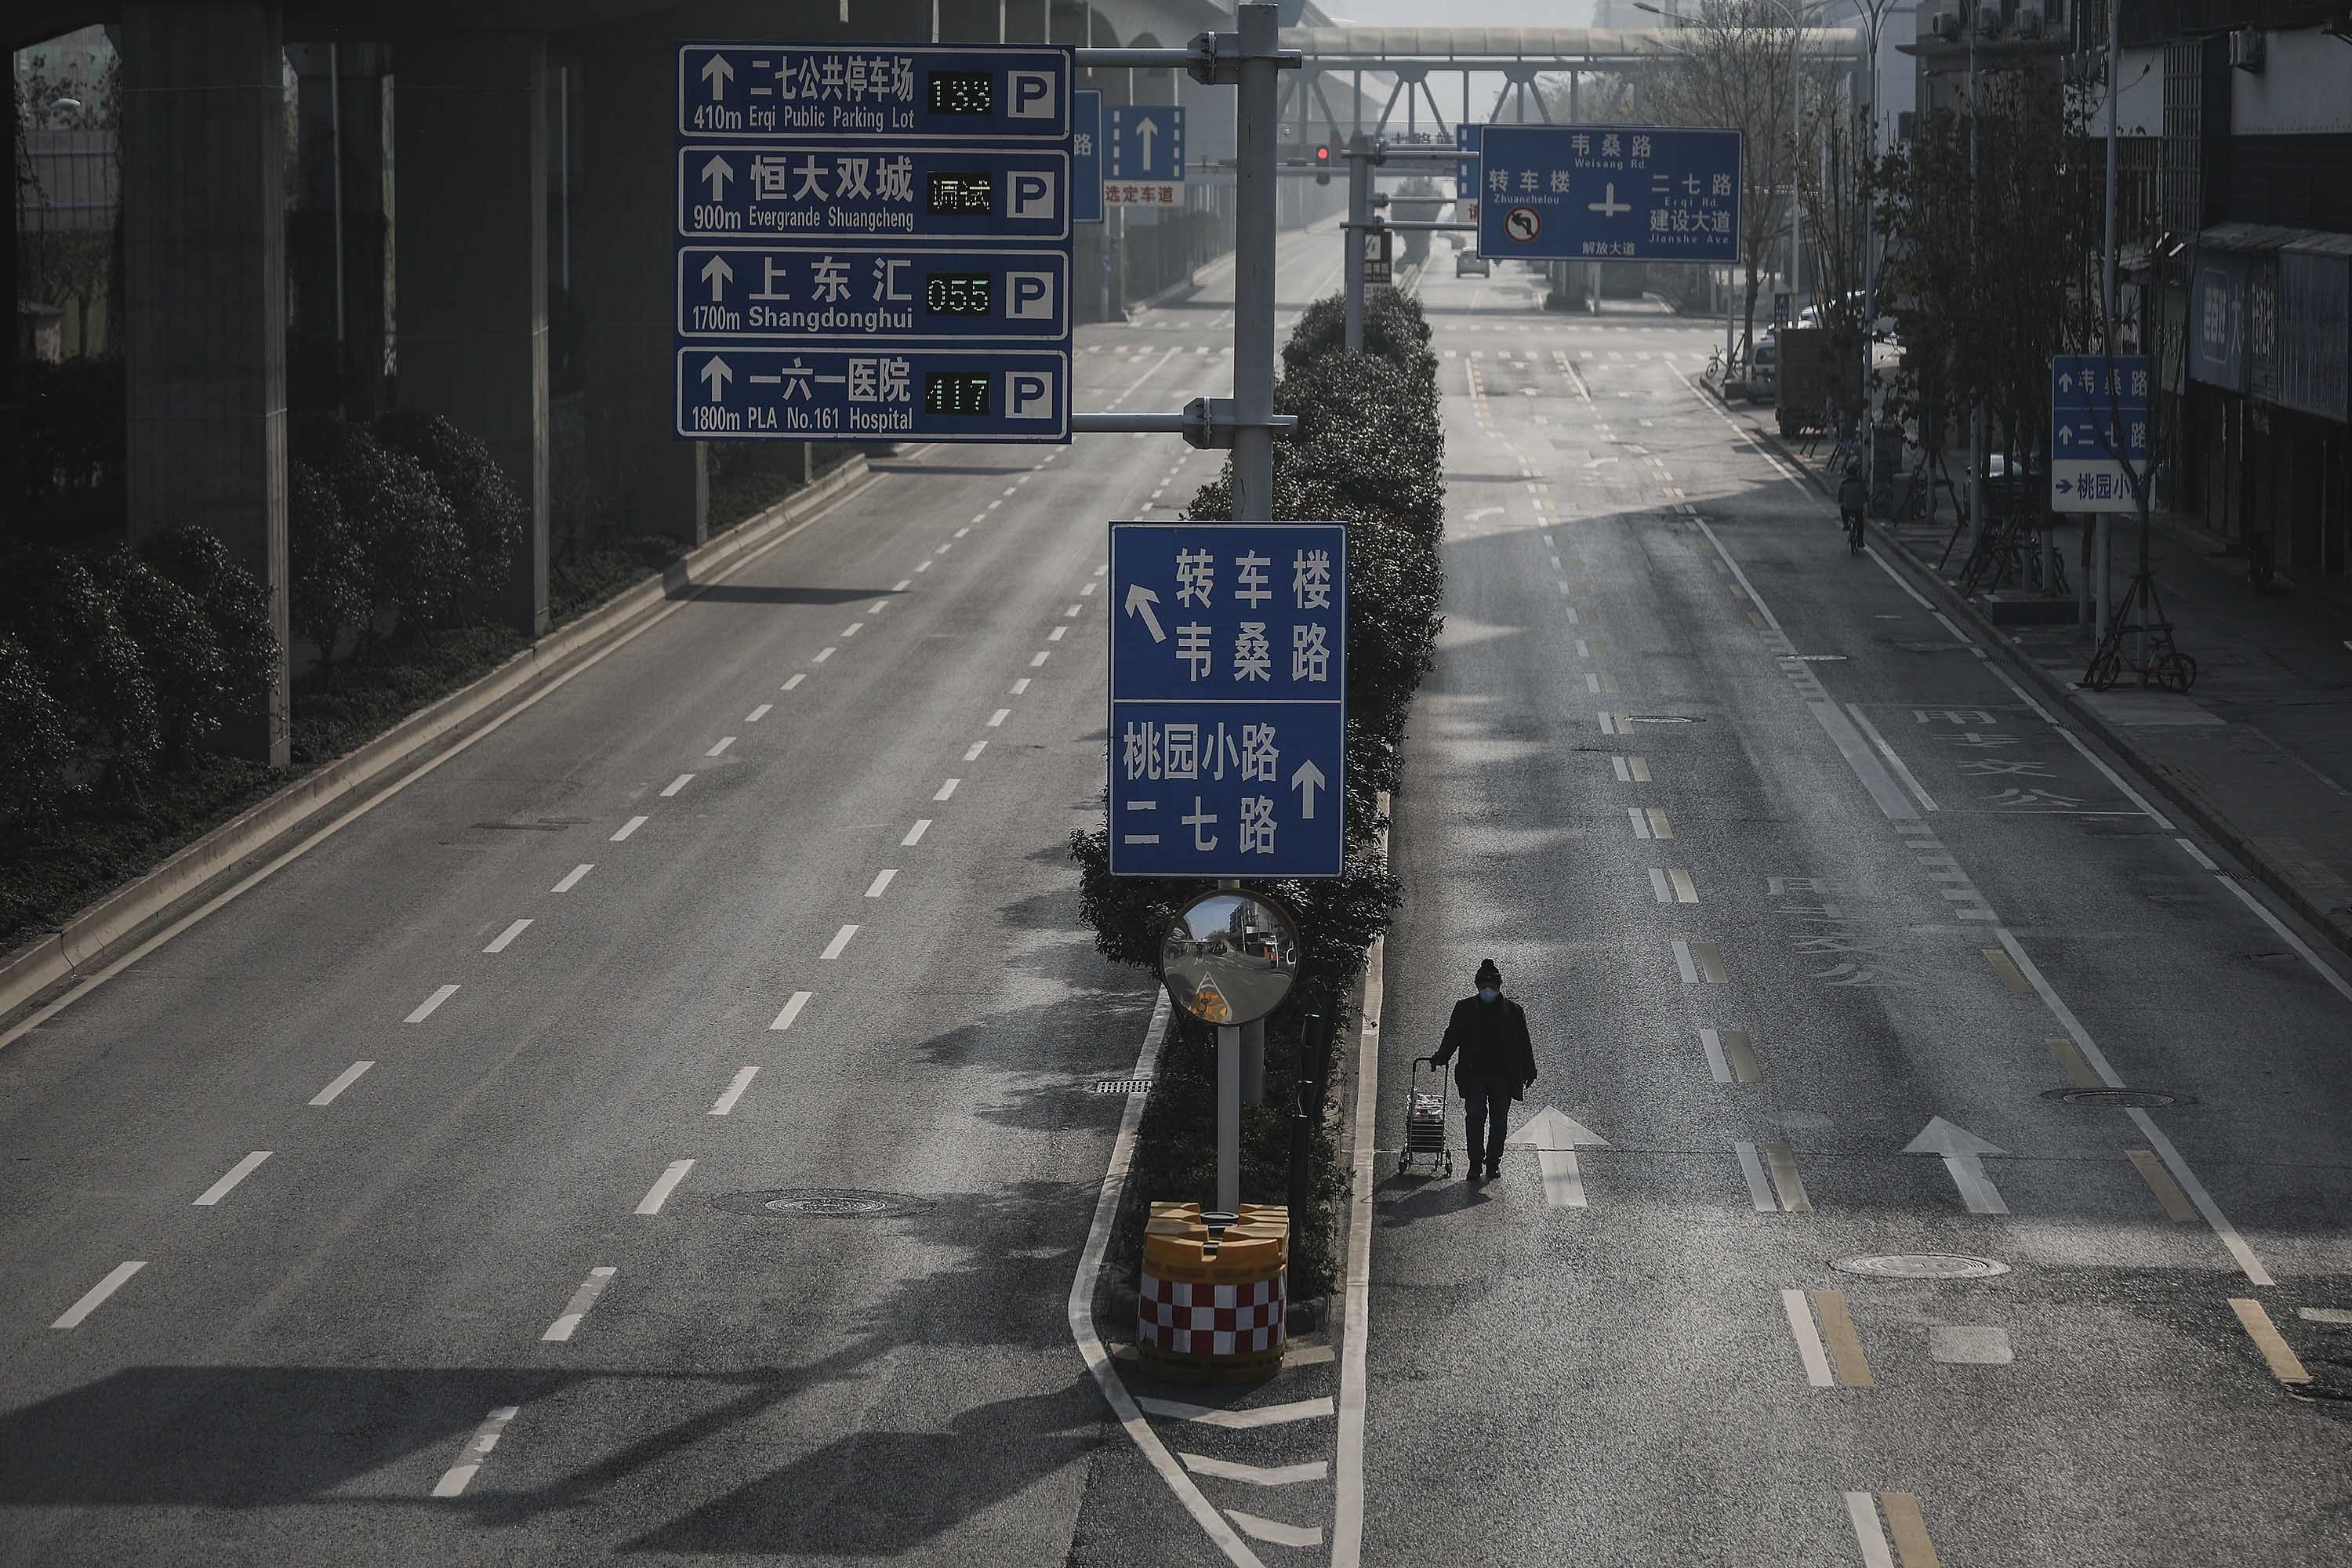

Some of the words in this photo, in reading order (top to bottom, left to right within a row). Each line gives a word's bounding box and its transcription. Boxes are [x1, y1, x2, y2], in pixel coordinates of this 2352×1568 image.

[750, 54, 914, 103] 二七公共停车场
[694, 106, 742, 129] 410m
[750, 106, 775, 131] Erqi
[784, 106, 826, 127] Public
[833, 106, 884, 132] Parking
[892, 107, 915, 129] Lot
[1571, 133, 1651, 157] 韦桑路
[1574, 158, 1624, 170] Weisang
[750, 155, 914, 202] 恒大双城
[1489, 169, 1570, 193] 转车楼
[1651, 173, 1732, 195] 二七路
[1105, 186, 1174, 203] 选定车道
[1494, 194, 1559, 205] Zhuanchelou
[693, 206, 742, 230] 900m
[750, 206, 822, 230] Evergrande
[828, 207, 914, 232] Shuangcheng
[1650, 209, 1731, 233] 建设大道
[1582, 241, 1635, 256] 解放大道
[749, 256, 913, 303] 上东汇
[929, 280, 989, 310] 055
[693, 306, 740, 330] 1700m
[749, 307, 913, 332] Shangdonghui
[750, 357, 911, 402] 一六一医院
[693, 406, 740, 430] 1800m
[748, 408, 778, 430] PLA
[787, 407, 840, 429] No.161
[850, 408, 913, 433] Hospital
[1176, 548, 1330, 609] 转车楼
[1176, 621, 1330, 682] 韦桑路
[1123, 721, 1279, 782] 桃园小路
[1124, 794, 1278, 854] 二七路
